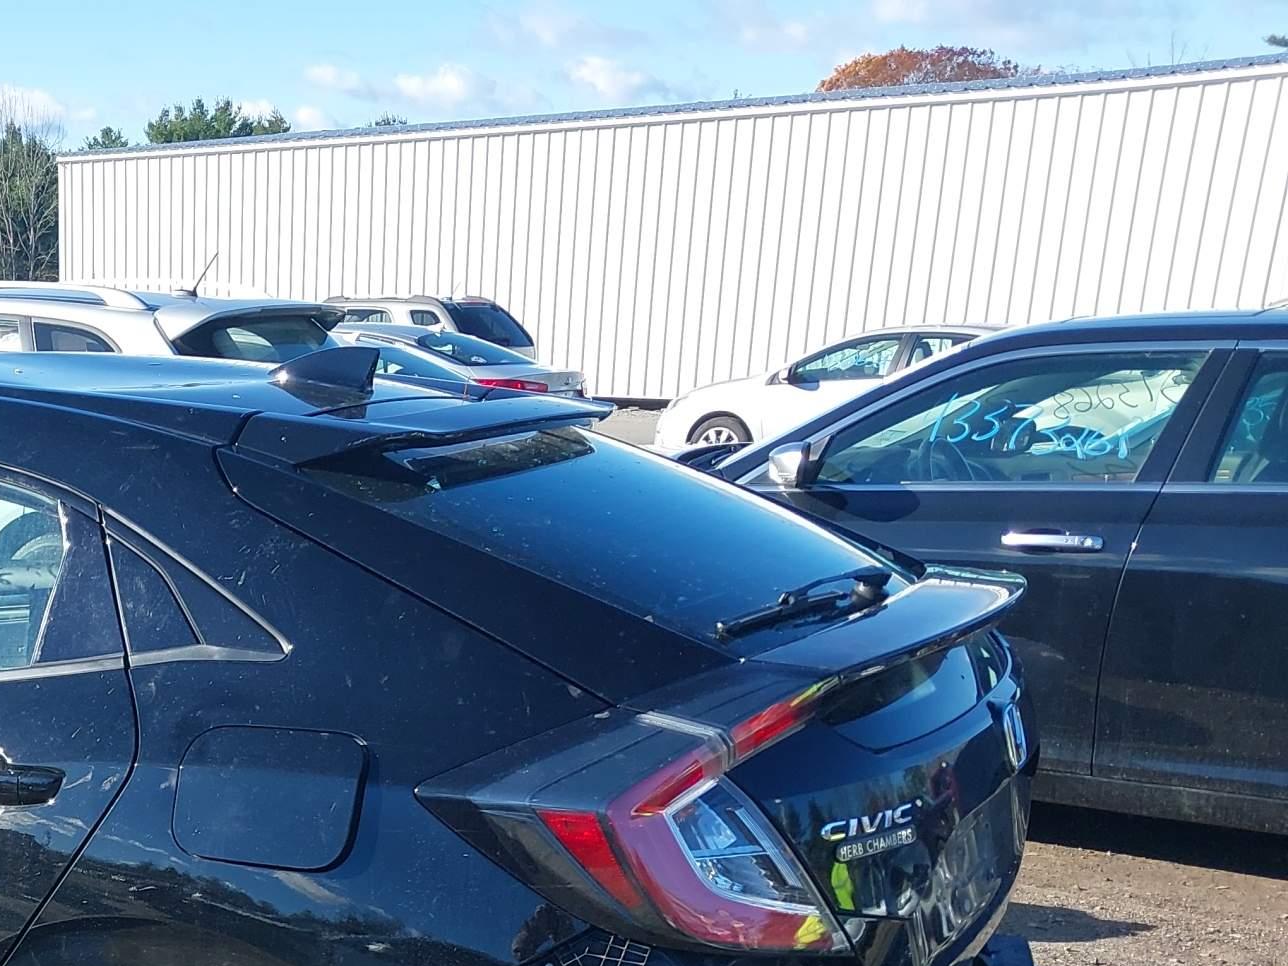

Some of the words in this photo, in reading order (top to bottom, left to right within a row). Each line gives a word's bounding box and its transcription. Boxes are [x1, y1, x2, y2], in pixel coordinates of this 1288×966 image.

[820, 803, 913, 841] CIVIC
[839, 842, 864, 860] HERB
[865, 827, 913, 853] CHAMBERS
